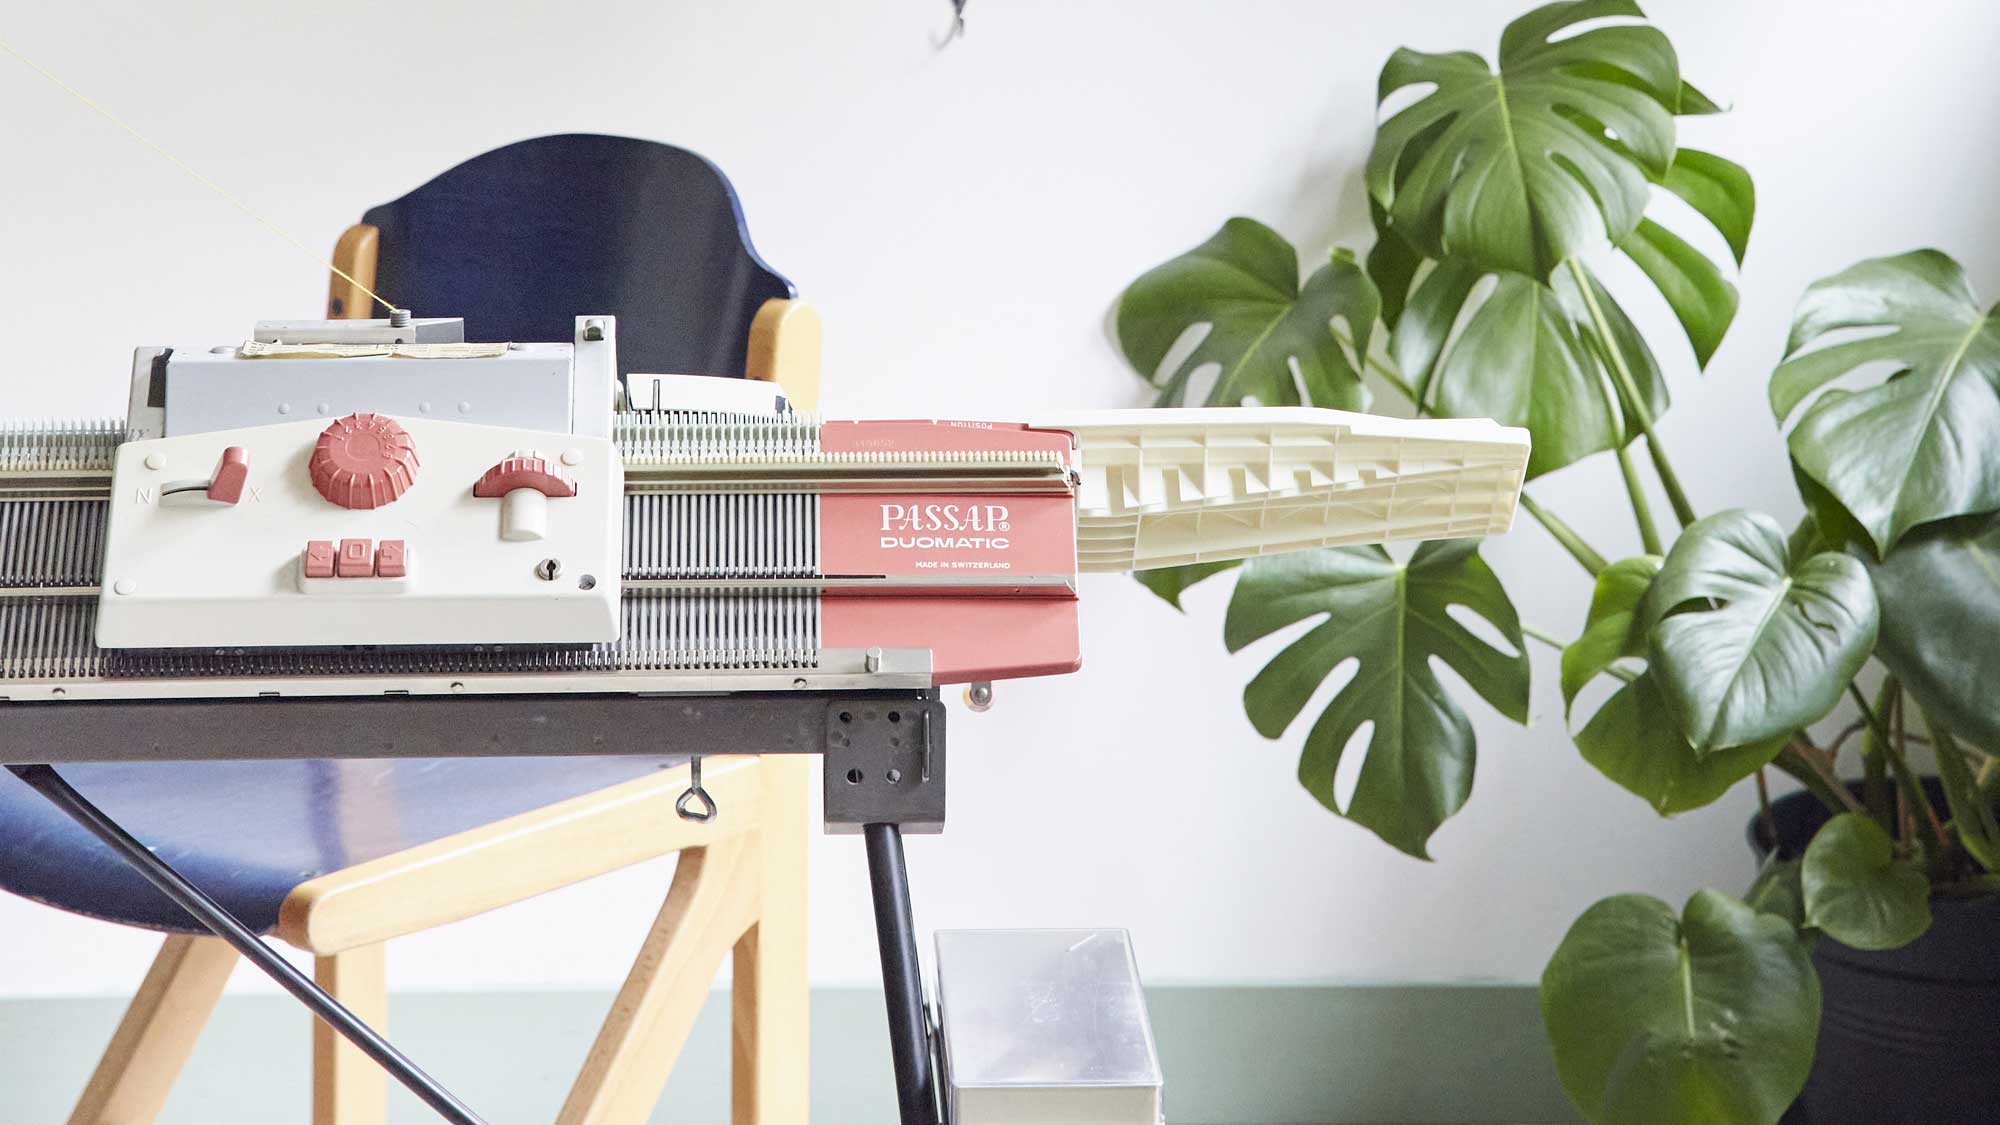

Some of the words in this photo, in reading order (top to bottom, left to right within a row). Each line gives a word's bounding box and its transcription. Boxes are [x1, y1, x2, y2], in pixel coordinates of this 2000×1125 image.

[880, 536, 1009, 549] DUOMATIC
[915, 561, 938, 569] MADE
[940, 561, 949, 569] IN
[951, 561, 1010, 569] SWITZERLAND
